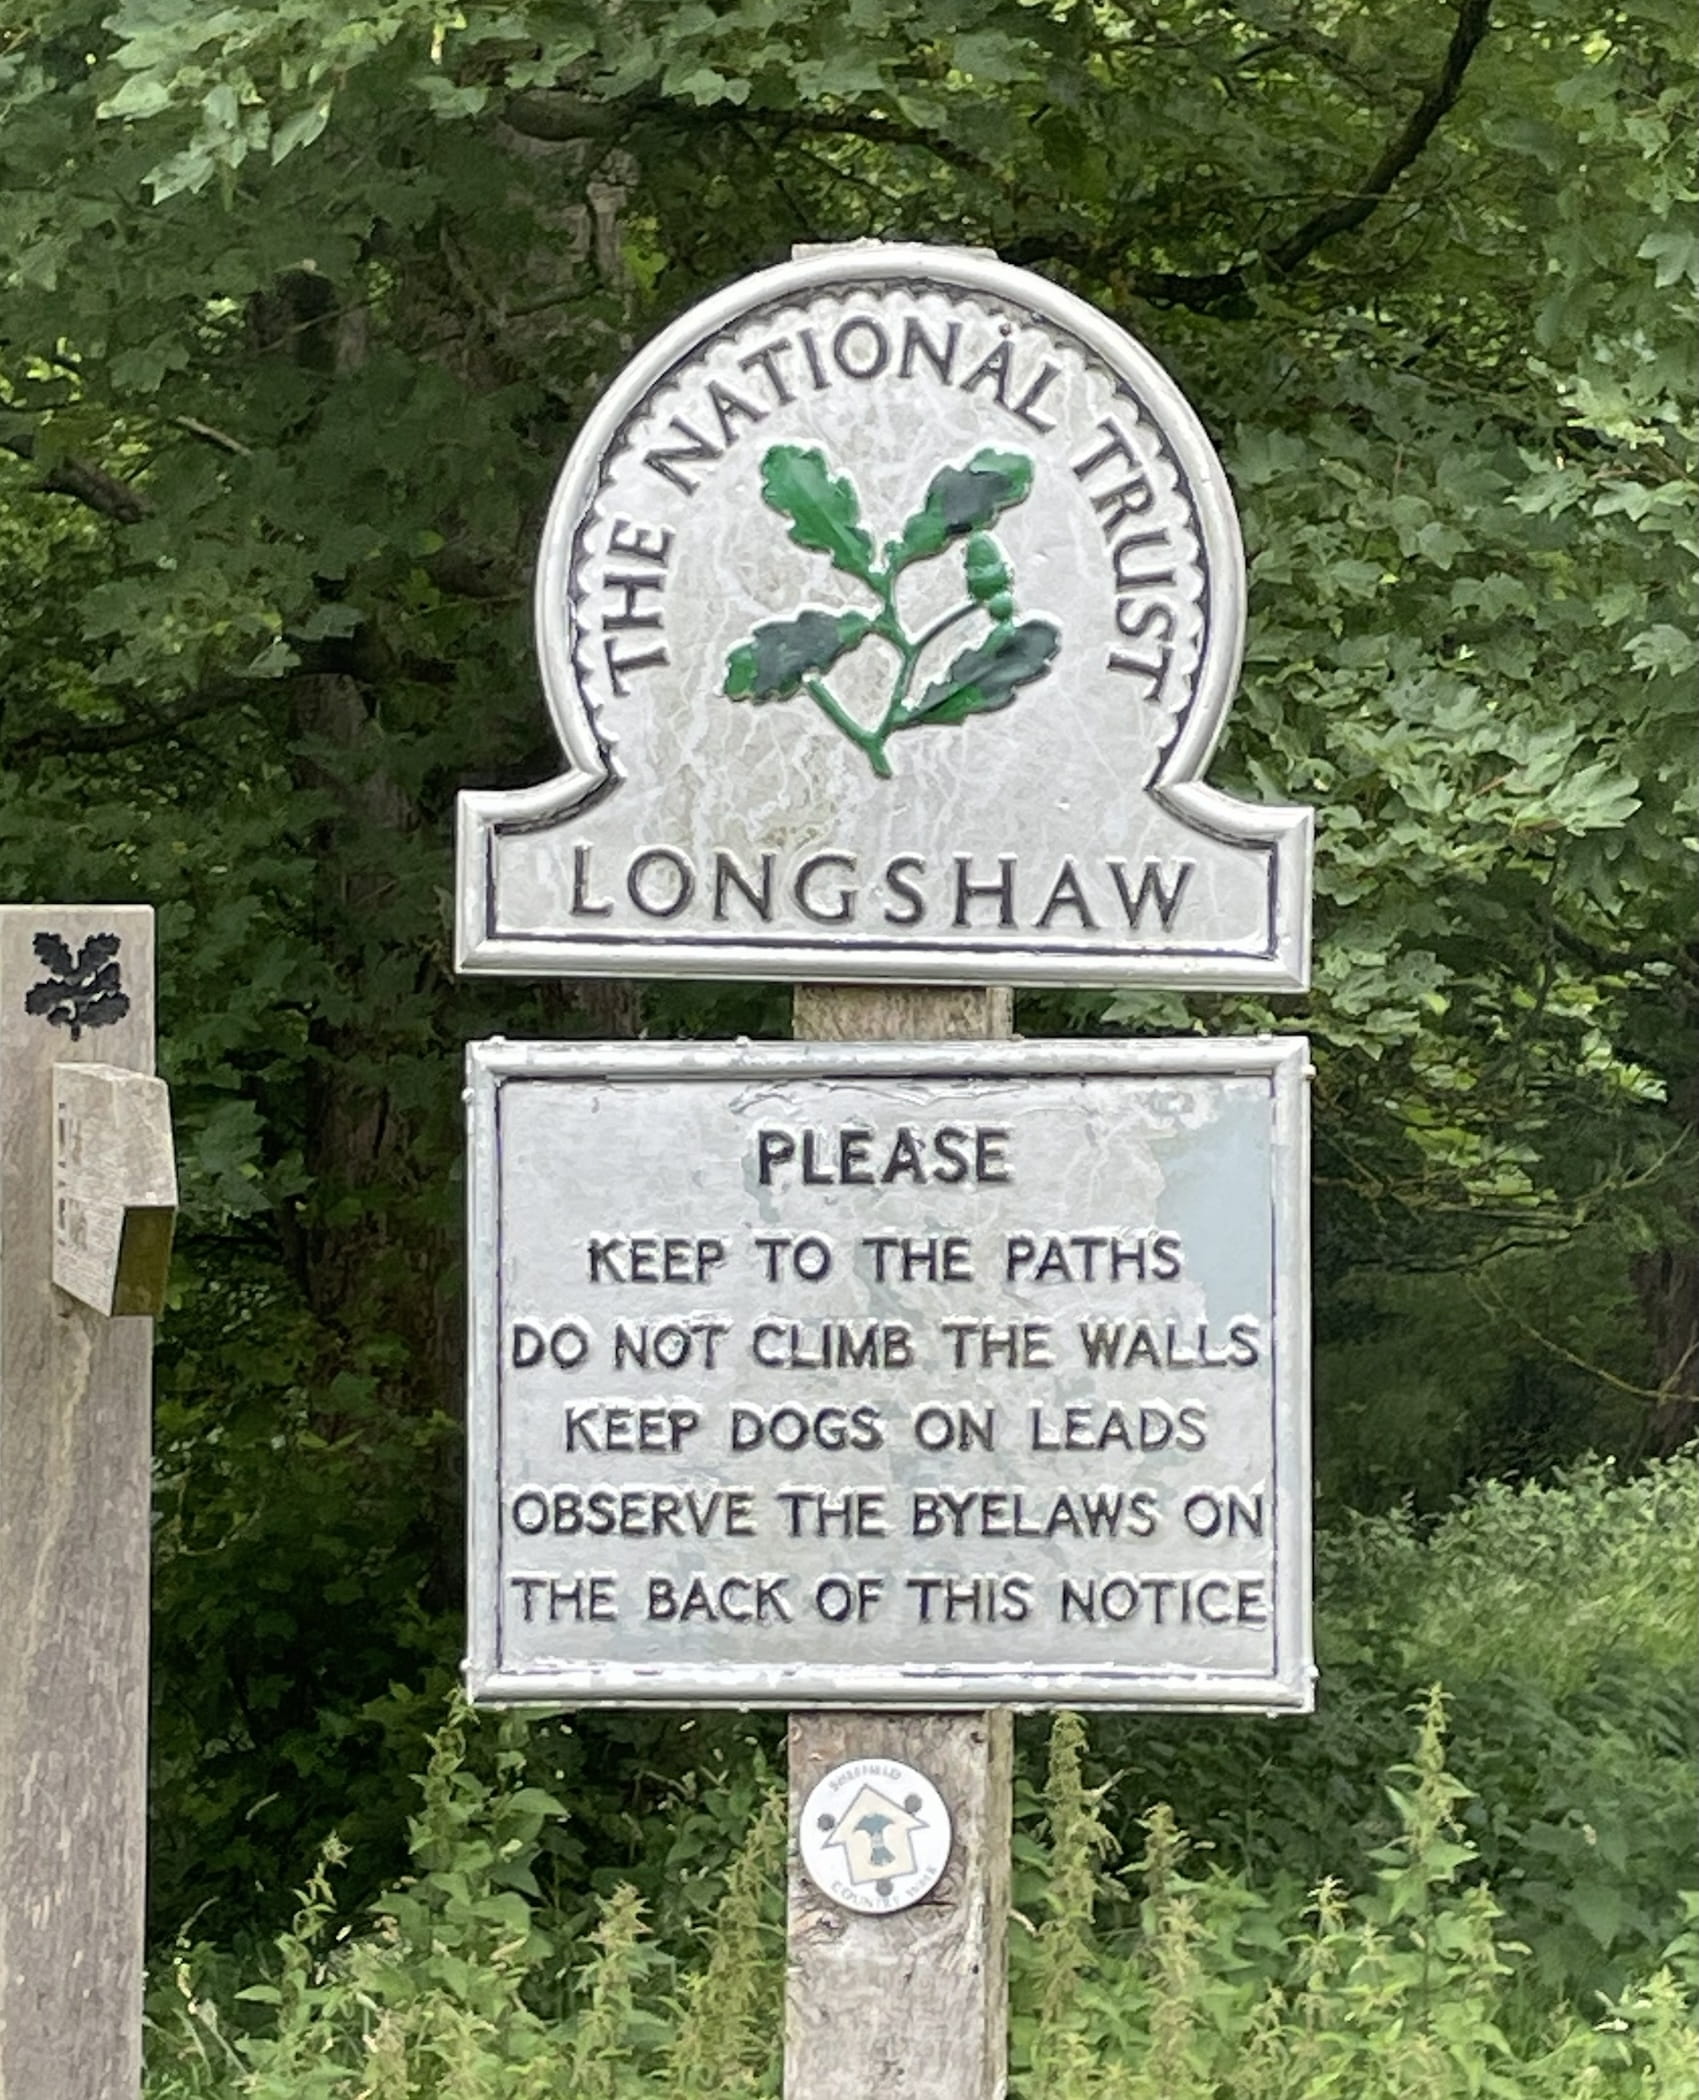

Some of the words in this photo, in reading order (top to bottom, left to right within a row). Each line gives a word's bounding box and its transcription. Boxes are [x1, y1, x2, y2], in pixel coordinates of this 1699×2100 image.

[603, 519, 674, 698] THE
[644, 316, 1060, 495] NATIONAL
[1072, 419, 1174, 701] TRUST
[573, 847, 1191, 931] LONGSHAW
[759, 1128, 1010, 1186] PLEASE
[588, 1239, 724, 1284] KEEP
[755, 1238, 831, 1283] TO
[862, 1237, 972, 1283] THE
[1007, 1236, 1179, 1282] PATHS
[513, 1325, 588, 1370] DO
[615, 1325, 728, 1370] NOT
[753, 1324, 913, 1369] CLIMB
[942, 1324, 1051, 1368] THE
[1080, 1324, 1258, 1368] WALLS
[566, 1409, 698, 1453] KEEP
[732, 1407, 883, 1452] DOGS
[915, 1409, 994, 1452] ON
[1032, 1409, 1205, 1452] LEADS
[512, 1491, 755, 1538] OBSERVE
[779, 1493, 885, 1538] THE
[913, 1493, 1156, 1538] BYELAWS
[1184, 1495, 1262, 1537] ON
[511, 1578, 616, 1622] THE
[648, 1578, 792, 1623] BACK
[816, 1579, 884, 1623] OF
[906, 1579, 1029, 1624] THIS
[1062, 1580, 1265, 1624] NOTICE
